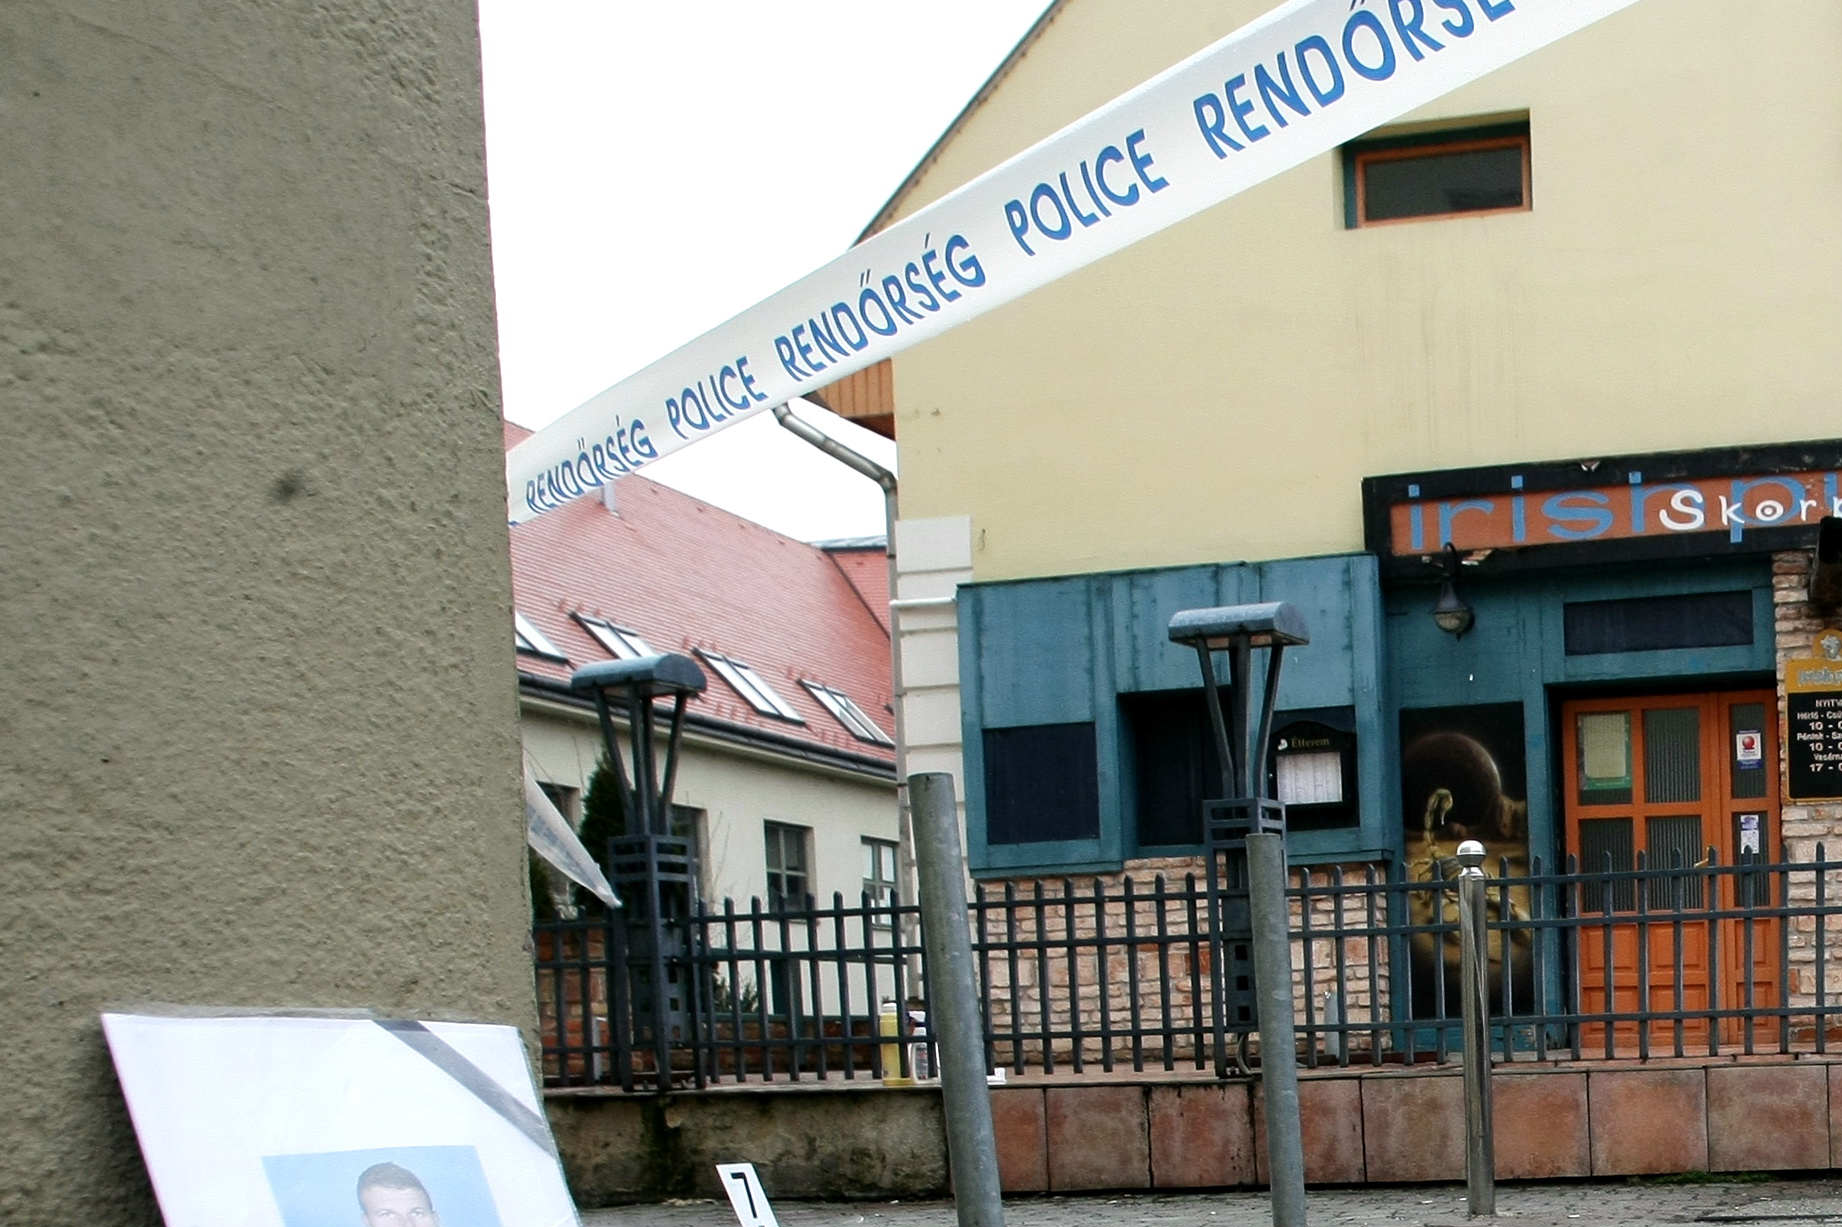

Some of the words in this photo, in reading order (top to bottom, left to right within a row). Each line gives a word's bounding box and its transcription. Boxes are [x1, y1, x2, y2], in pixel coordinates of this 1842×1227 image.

[526, 415, 659, 514] RENDŐRSÉG
[665, 355, 769, 440] POLICE
[774, 233, 986, 382] RENDŐRSÉG
[1004, 128, 1170, 257] POLICE
[1809, 721, 1824, 731] 10
[1809, 742, 1824, 751] 10
[1809, 763, 1824, 772] 17
[730, 1172, 758, 1218] 7
